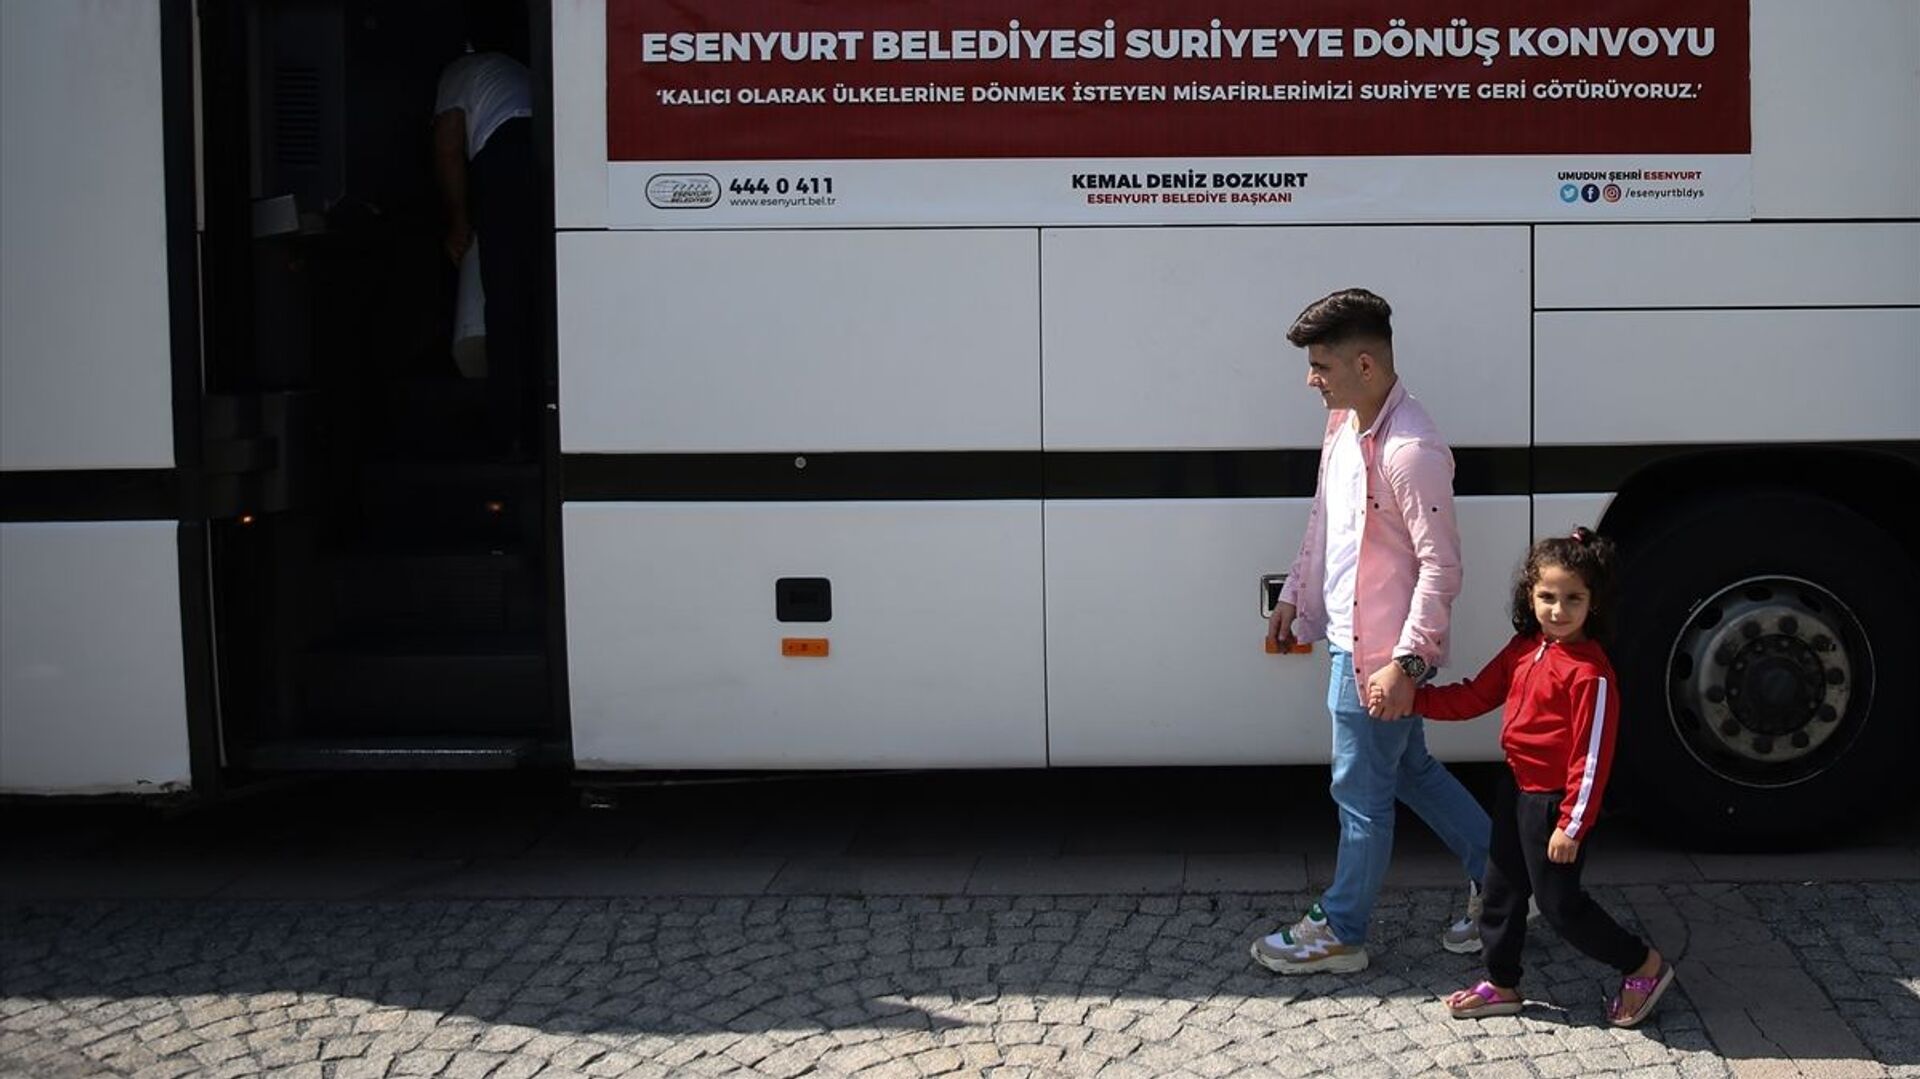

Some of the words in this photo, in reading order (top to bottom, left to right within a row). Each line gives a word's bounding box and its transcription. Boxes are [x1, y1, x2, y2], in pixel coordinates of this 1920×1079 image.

[643, 32, 864, 61] ESENYURT
[873, 19, 1114, 59] BELEDİYESİ
[1125, 19, 1343, 58] SURİYE’YE
[1354, 19, 1499, 66] DÖNÜŞ
[1510, 28, 1714, 56] KONVOYU
[738, 88, 825, 103] OLARAK
[833, 83, 964, 102] ÜLKELERİNE
[972, 83, 1065, 101] DÖNMEK
[1073, 82, 1165, 100] İSTEYEN
[1174, 80, 1352, 100] MİSAFİRLERİMİZİ
[1361, 80, 1470, 99] SURİYE’YE
[1477, 80, 1525, 98] GERİ
[1072, 174, 1142, 189] KEMAL
[1147, 169, 1207, 188] DENİZ
[1213, 173, 1308, 188] BOZKURT
[1558, 172, 1606, 180] UMUDUN
[1609, 169, 1641, 182] ŞEHRİ
[1644, 171, 1702, 180] ESENYURT
[730, 178, 770, 194] 444
[776, 178, 789, 194] 0
[796, 178, 832, 194] 411
[1625, 188, 1704, 199] /esenyurtbldys
[730, 196, 836, 208] www.esenyurt.bel.tr
[1088, 194, 1161, 204] ESENYURT
[1162, 191, 1227, 203] BELEDİYE
[1231, 192, 1291, 205] BAŞKANI
